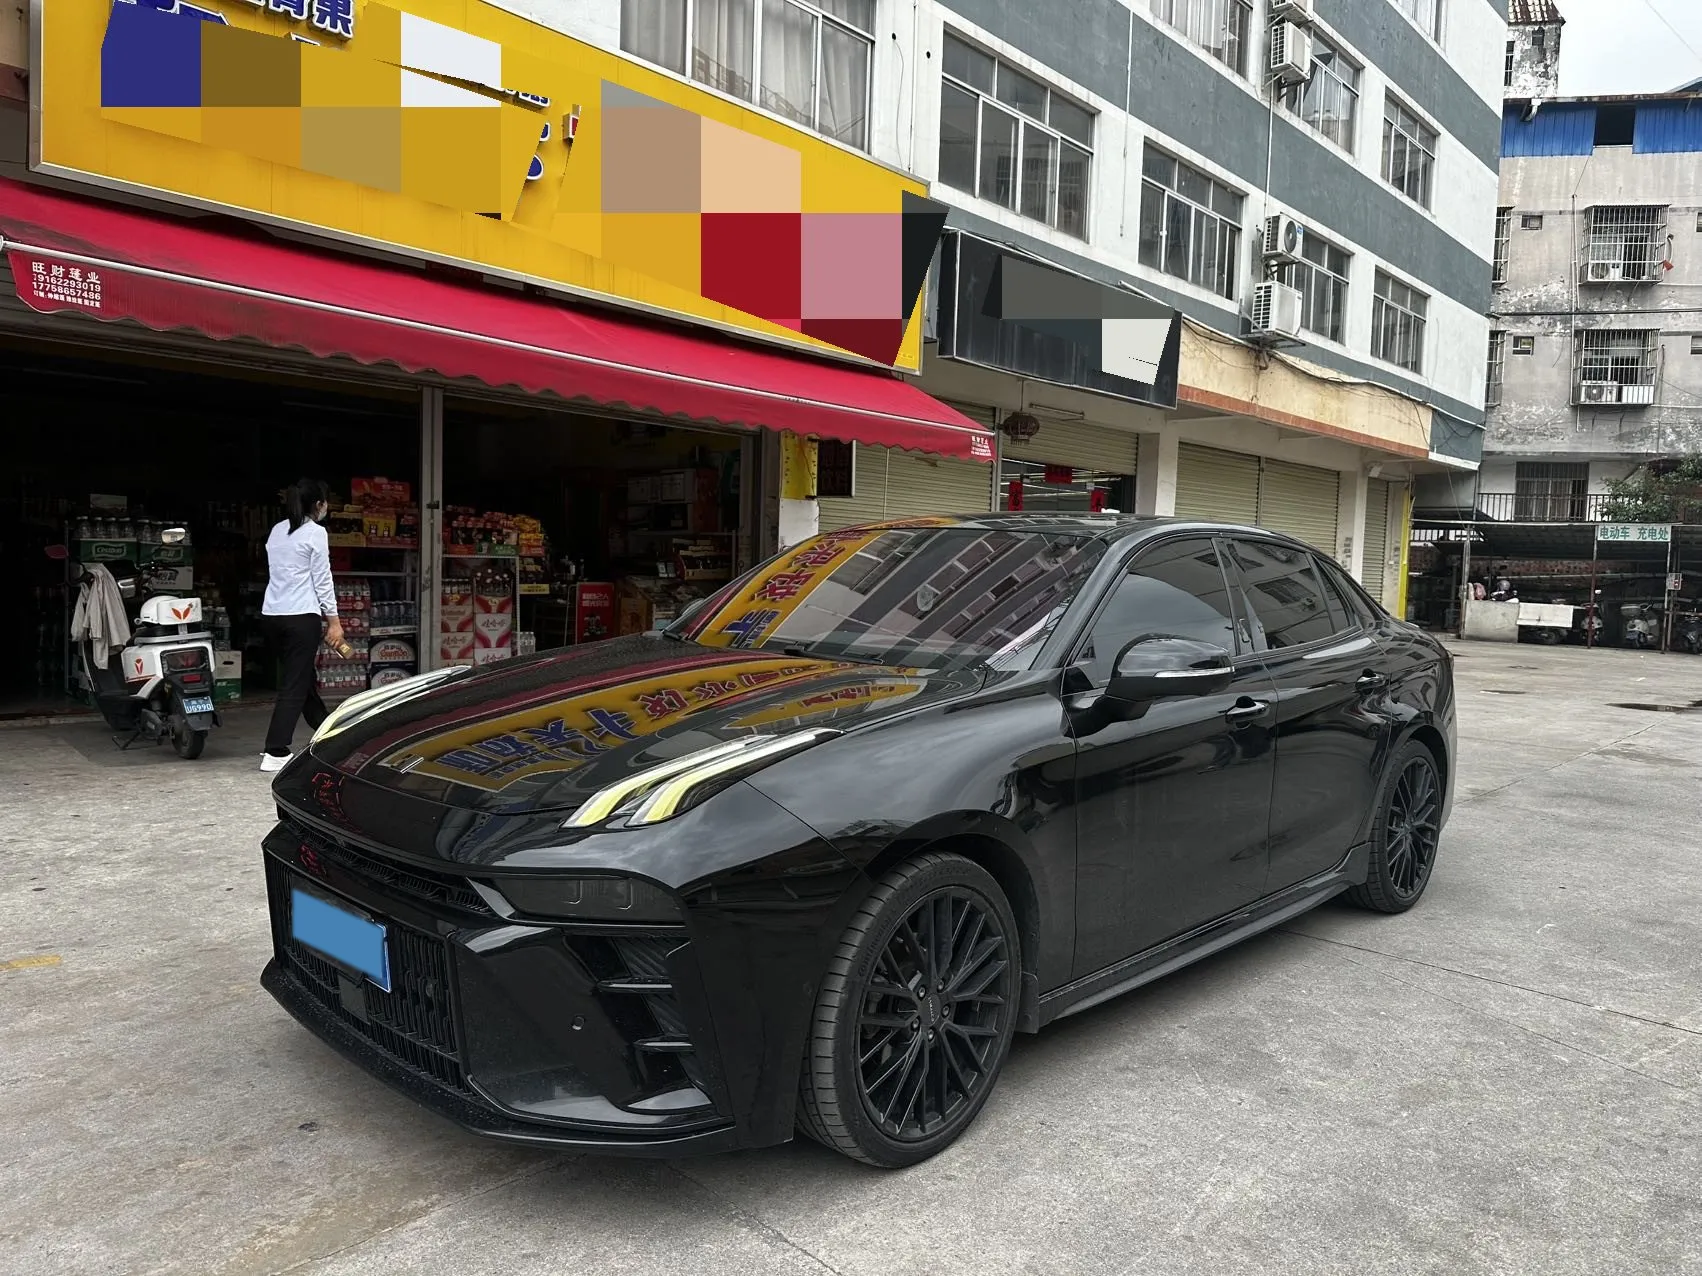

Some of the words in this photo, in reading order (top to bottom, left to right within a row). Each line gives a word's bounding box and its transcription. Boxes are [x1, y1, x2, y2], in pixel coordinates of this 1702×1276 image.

[32, 282, 101, 300] 17758657486
[1600, 525, 1630, 540] 电动车
[1637, 526, 1668, 540] 充电处
